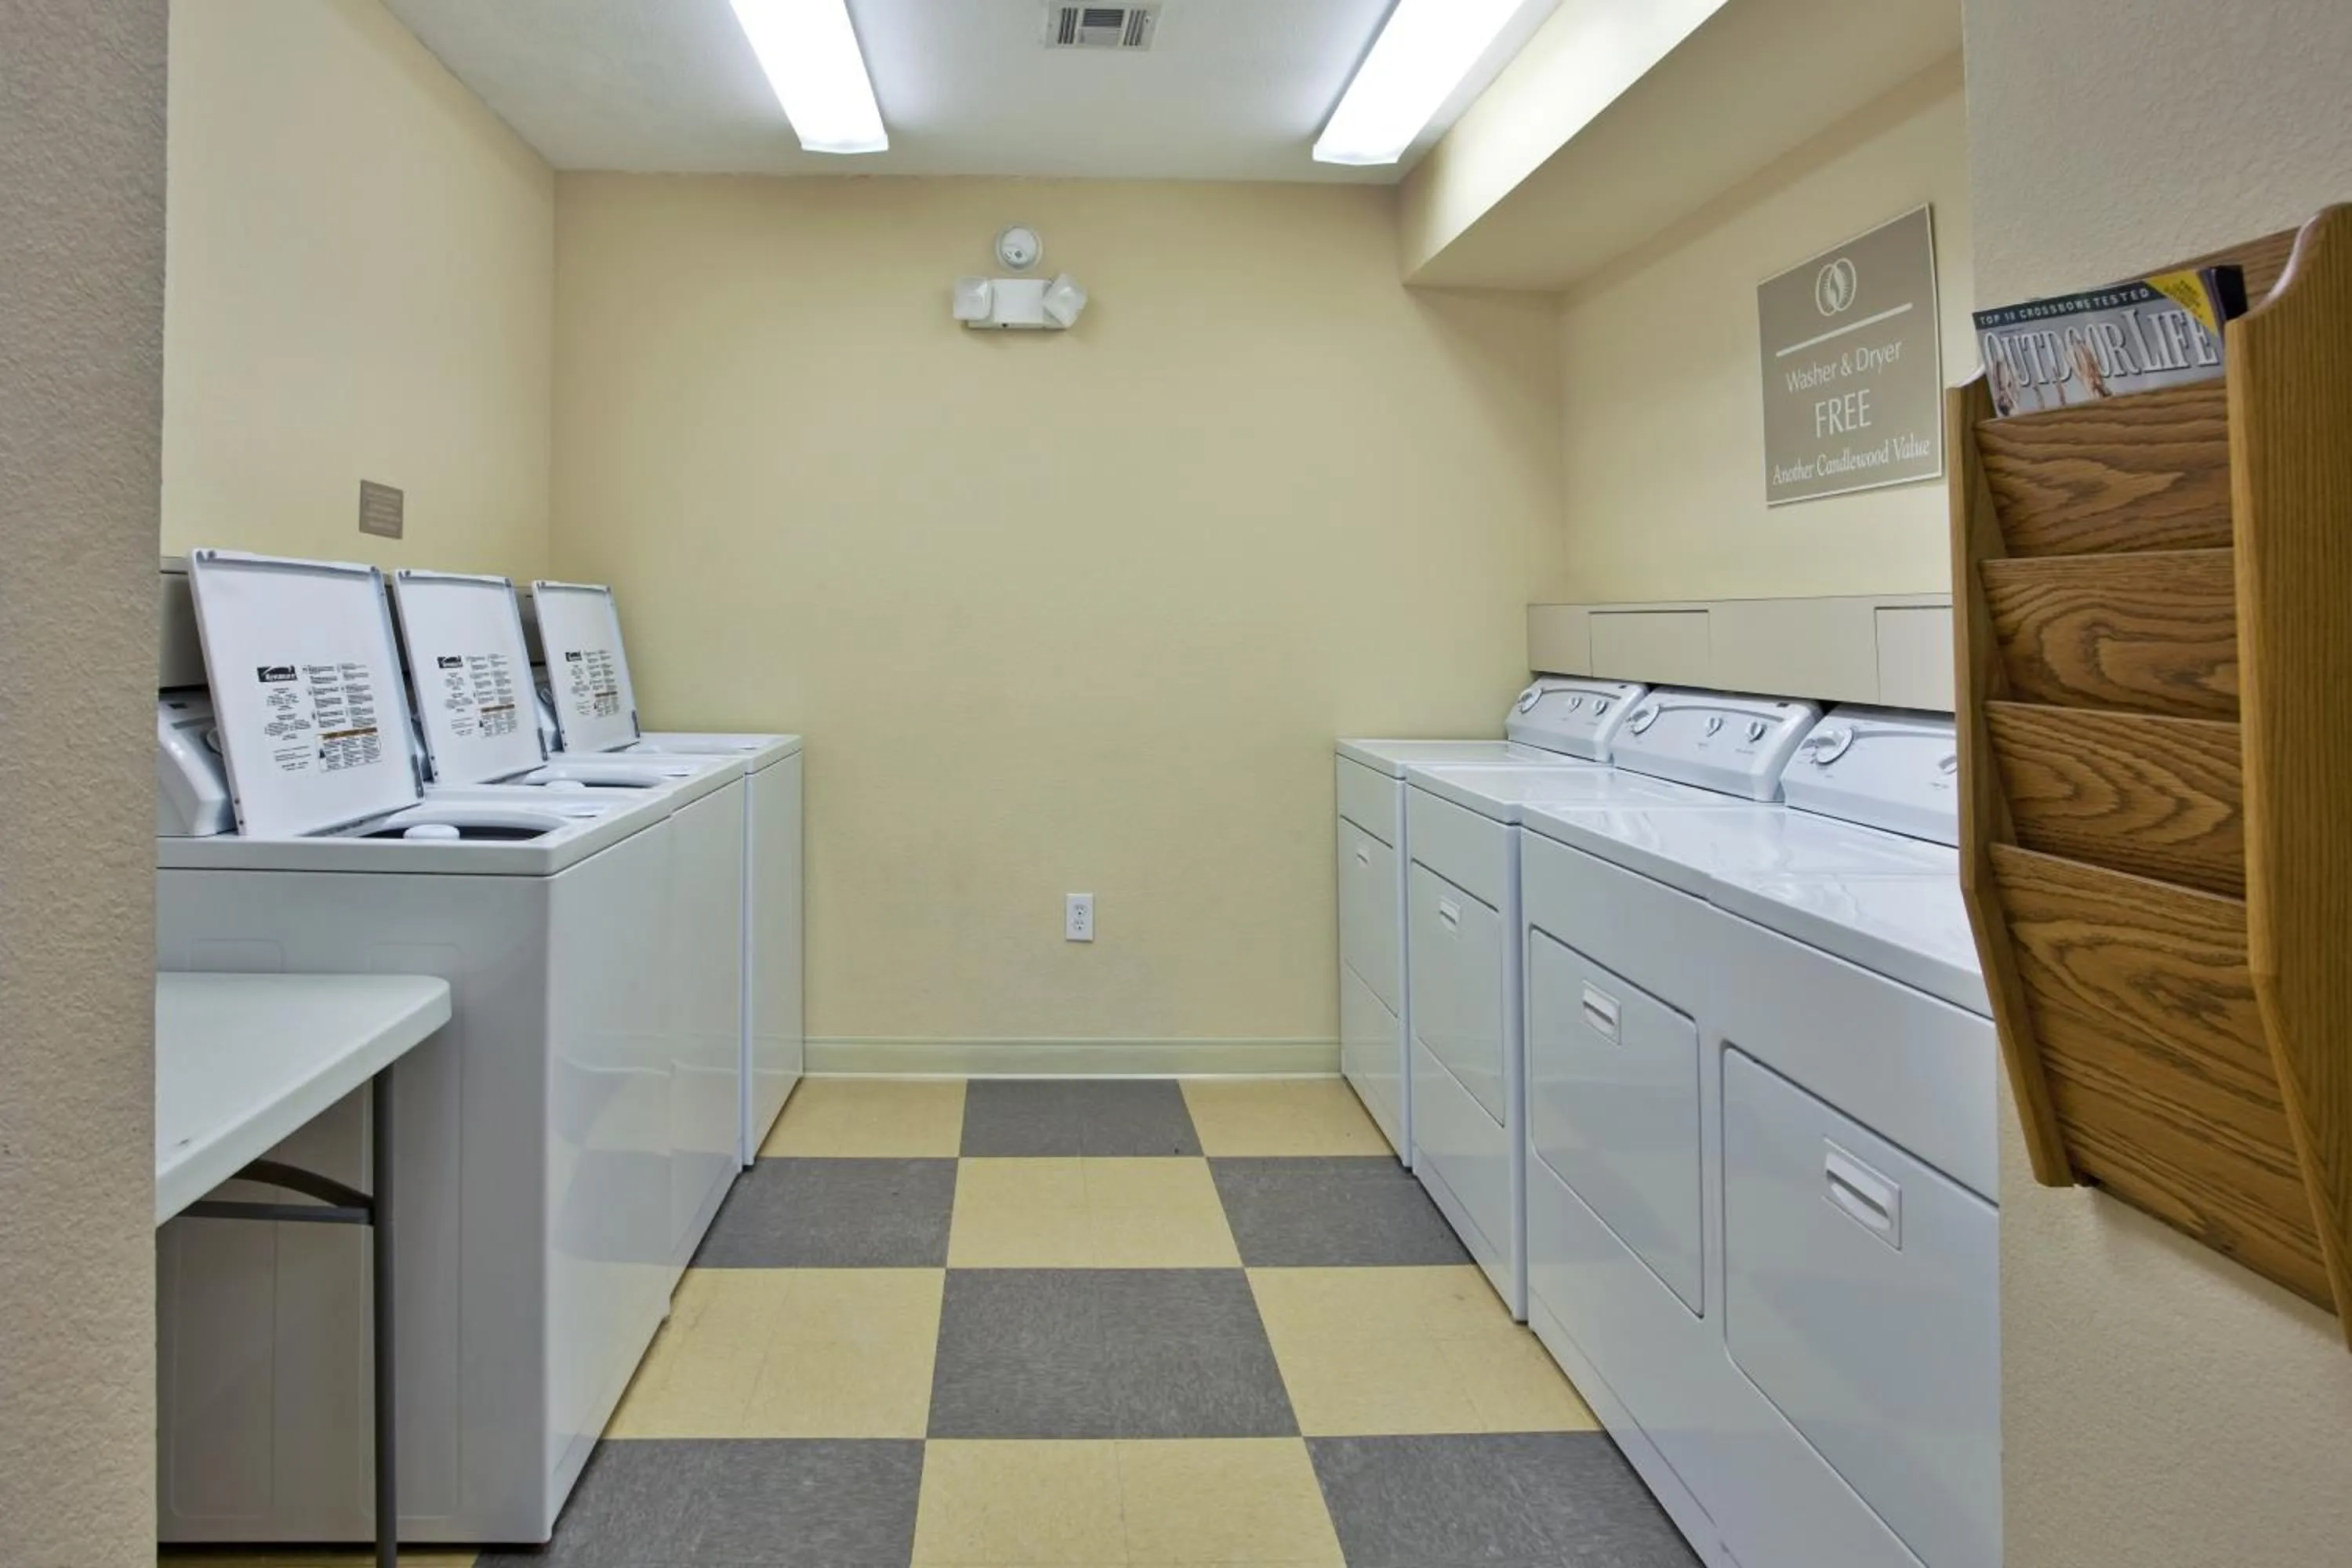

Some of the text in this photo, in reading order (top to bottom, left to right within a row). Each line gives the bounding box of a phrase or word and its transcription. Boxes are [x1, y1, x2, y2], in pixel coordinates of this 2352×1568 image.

[1979, 314, 2001, 326] TOP
[2020, 296, 2091, 319] CROSSBOWS
[2092, 287, 2151, 310] TESTED
[1786, 340, 1904, 394] Washer & Dryer
[1984, 308, 2221, 396] OUTDOOR LIFE
[1814, 389, 1872, 439] FREE
[1772, 433, 1930, 485] Another Candlewood Value
